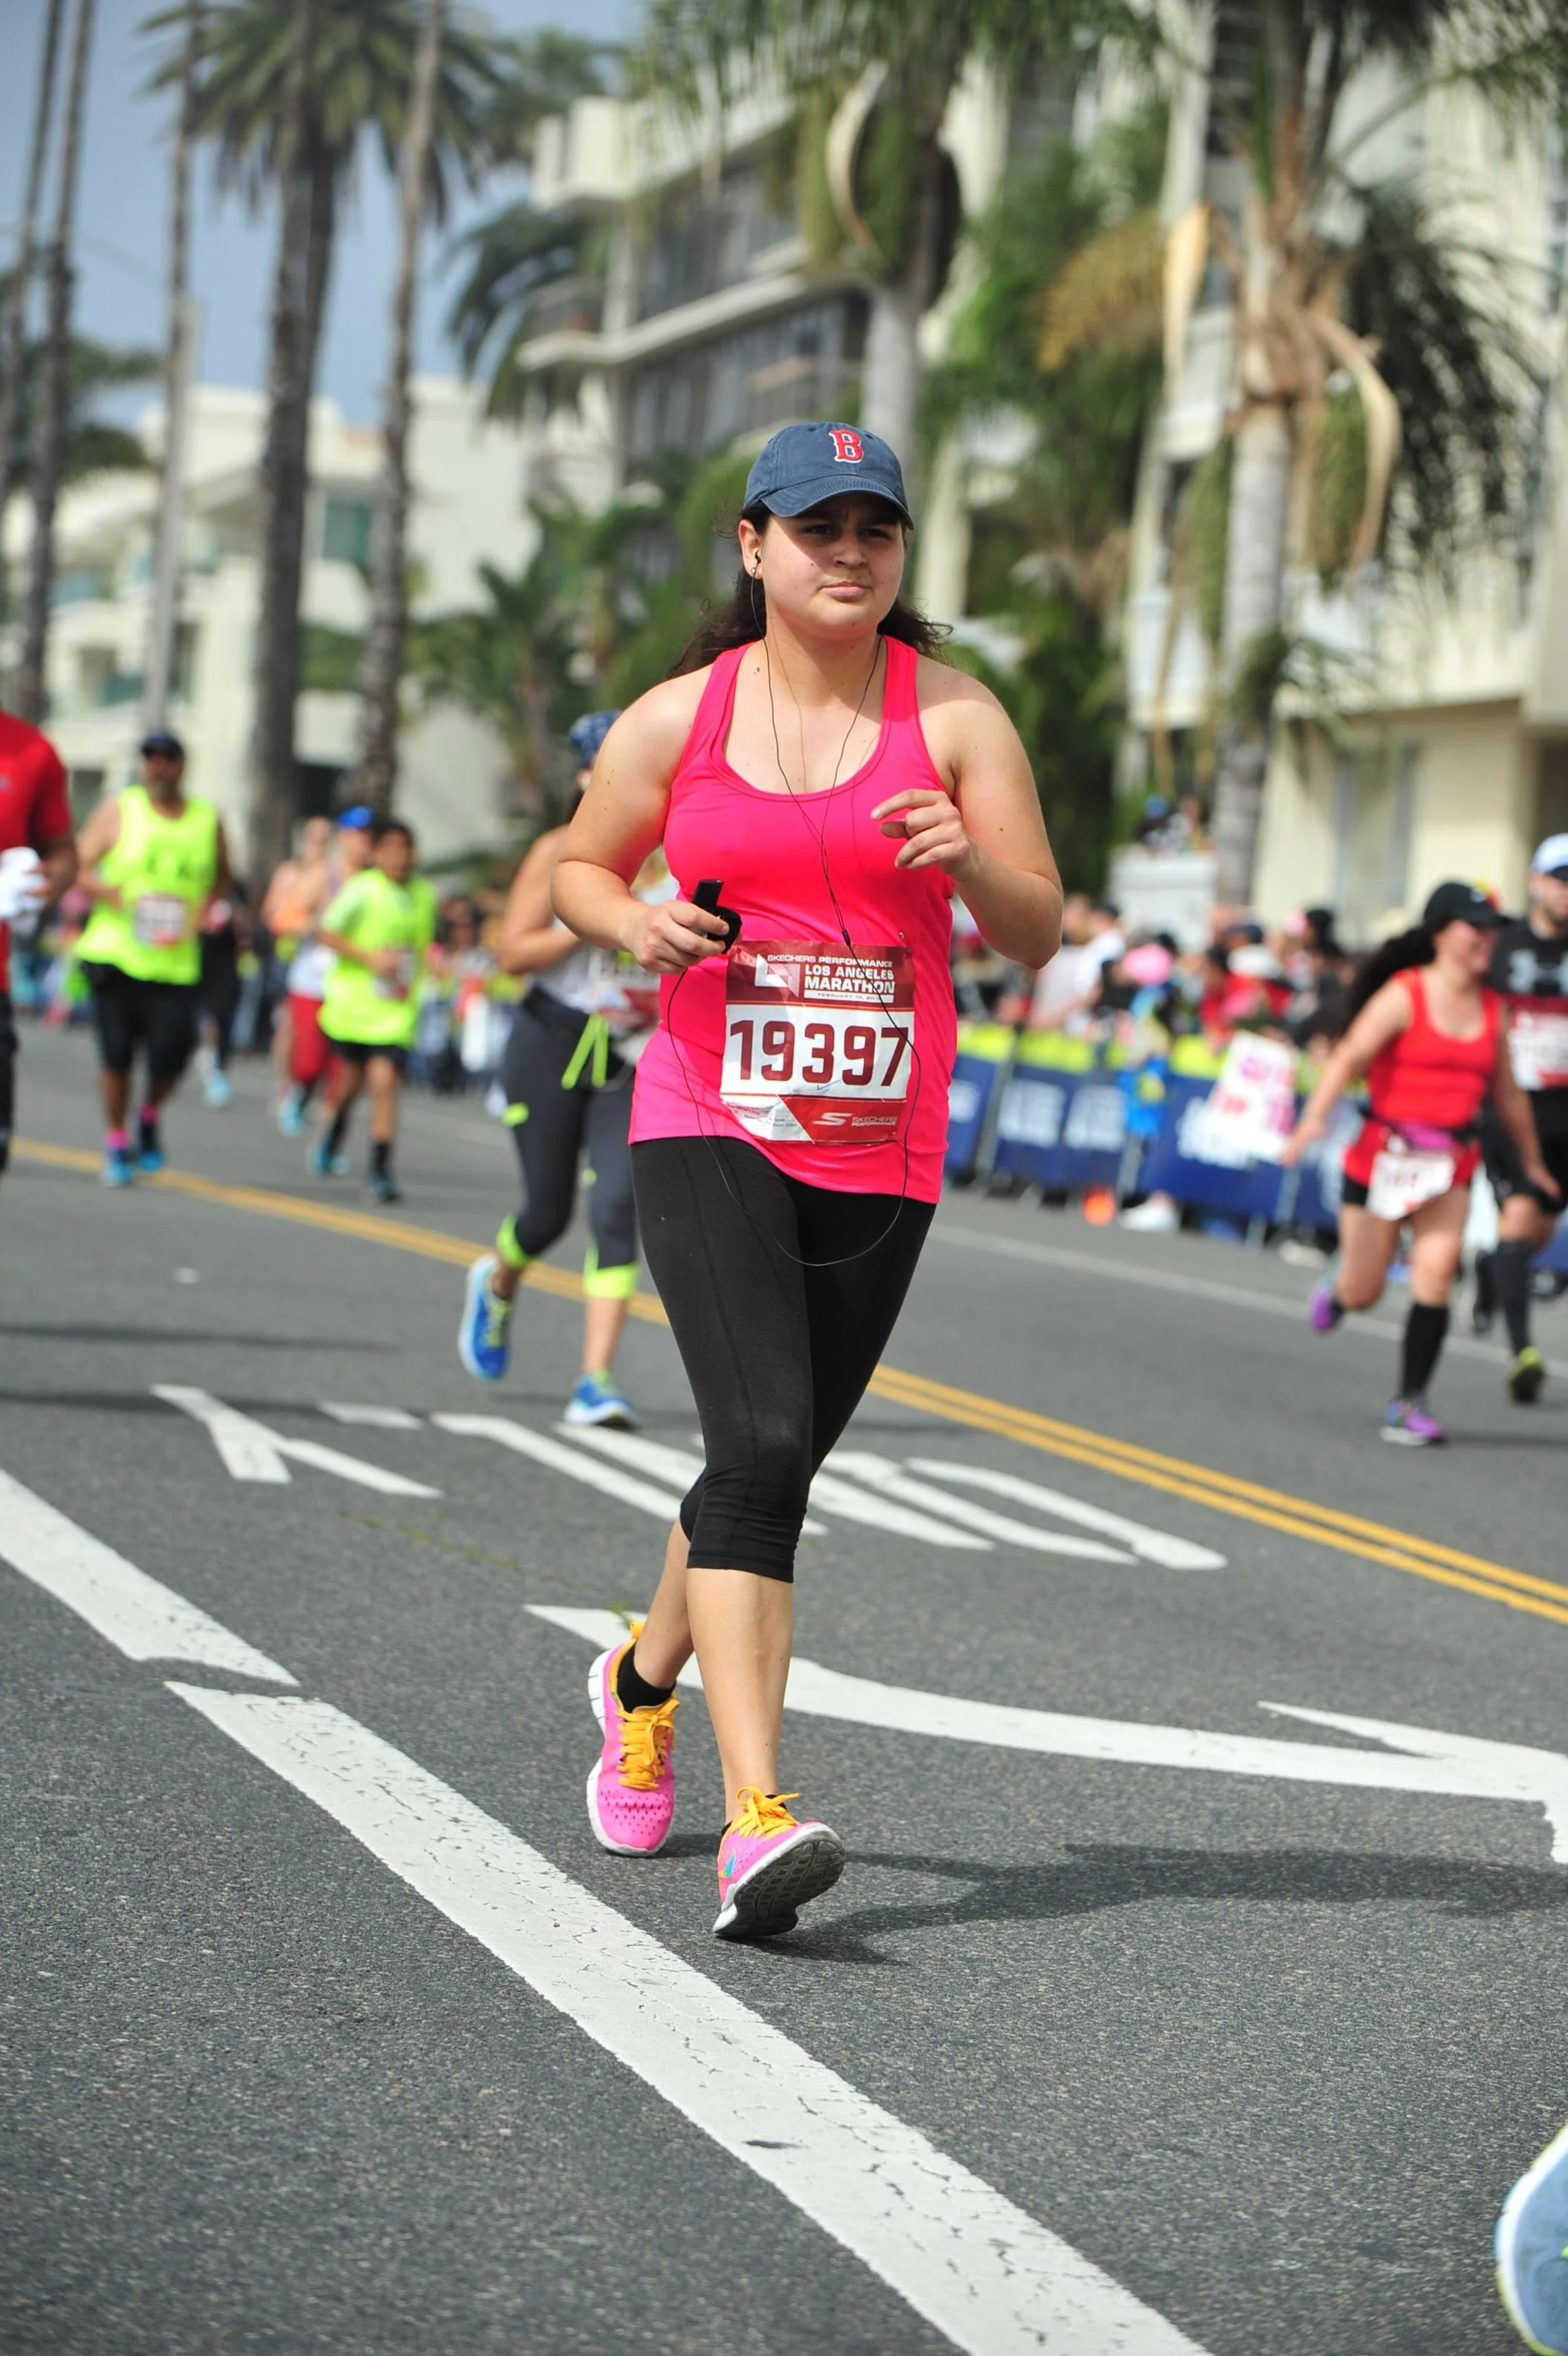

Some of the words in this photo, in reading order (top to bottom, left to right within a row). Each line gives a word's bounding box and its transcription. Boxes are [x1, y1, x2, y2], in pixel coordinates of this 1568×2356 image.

[829, 429, 864, 463] B
[767, 954, 816, 963] SKECHERS
[818, 956, 893, 968] PERFORMANCE
[804, 964, 831, 976] LOS
[835, 966, 894, 980] ANGELES
[804, 975, 895, 994] MARATHON
[730, 1019, 909, 1087] 19397
